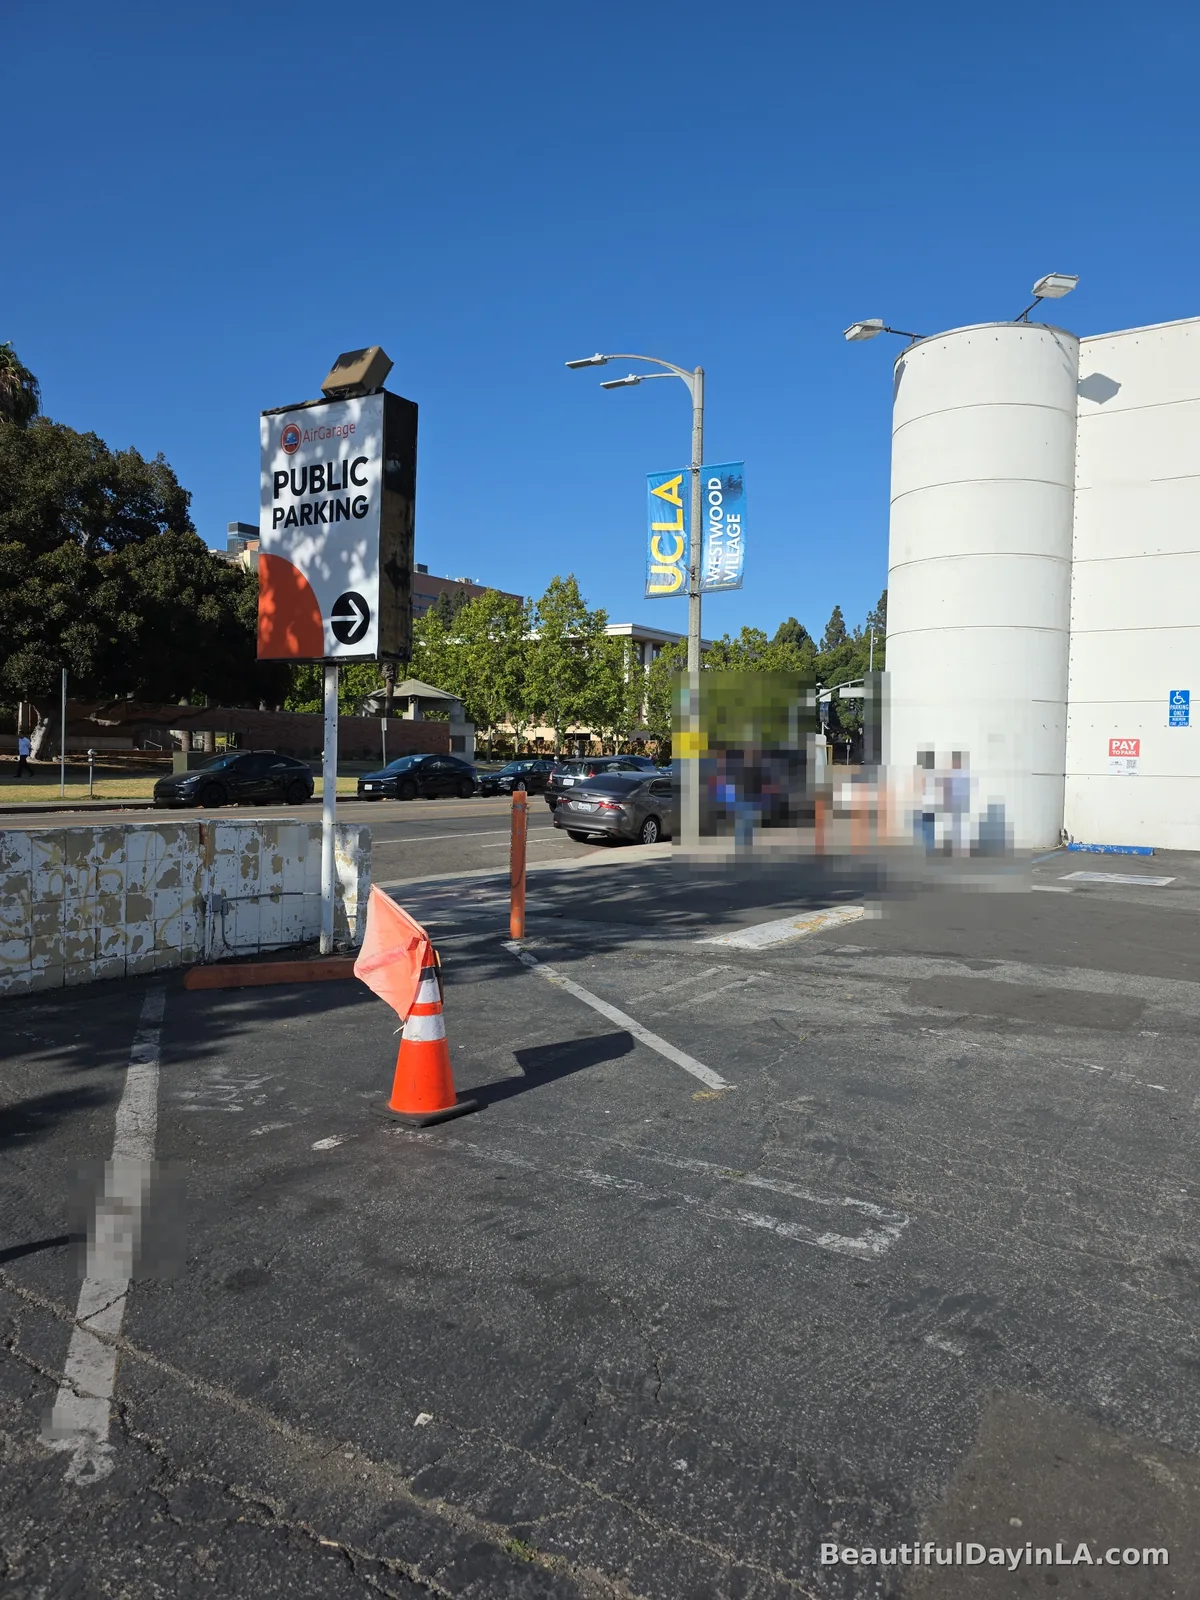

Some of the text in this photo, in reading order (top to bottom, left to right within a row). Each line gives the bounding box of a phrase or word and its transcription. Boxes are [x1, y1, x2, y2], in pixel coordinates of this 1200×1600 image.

[303, 423, 356, 443] AirGarage
[273, 456, 369, 499] PUBLIC
[272, 494, 369, 530] PARKING
[649, 474, 684, 592] UCLA
[706, 477, 723, 582] WESTWOOD
[723, 513, 741, 581] VILLAGE
[1112, 740, 1137, 750] PAY
